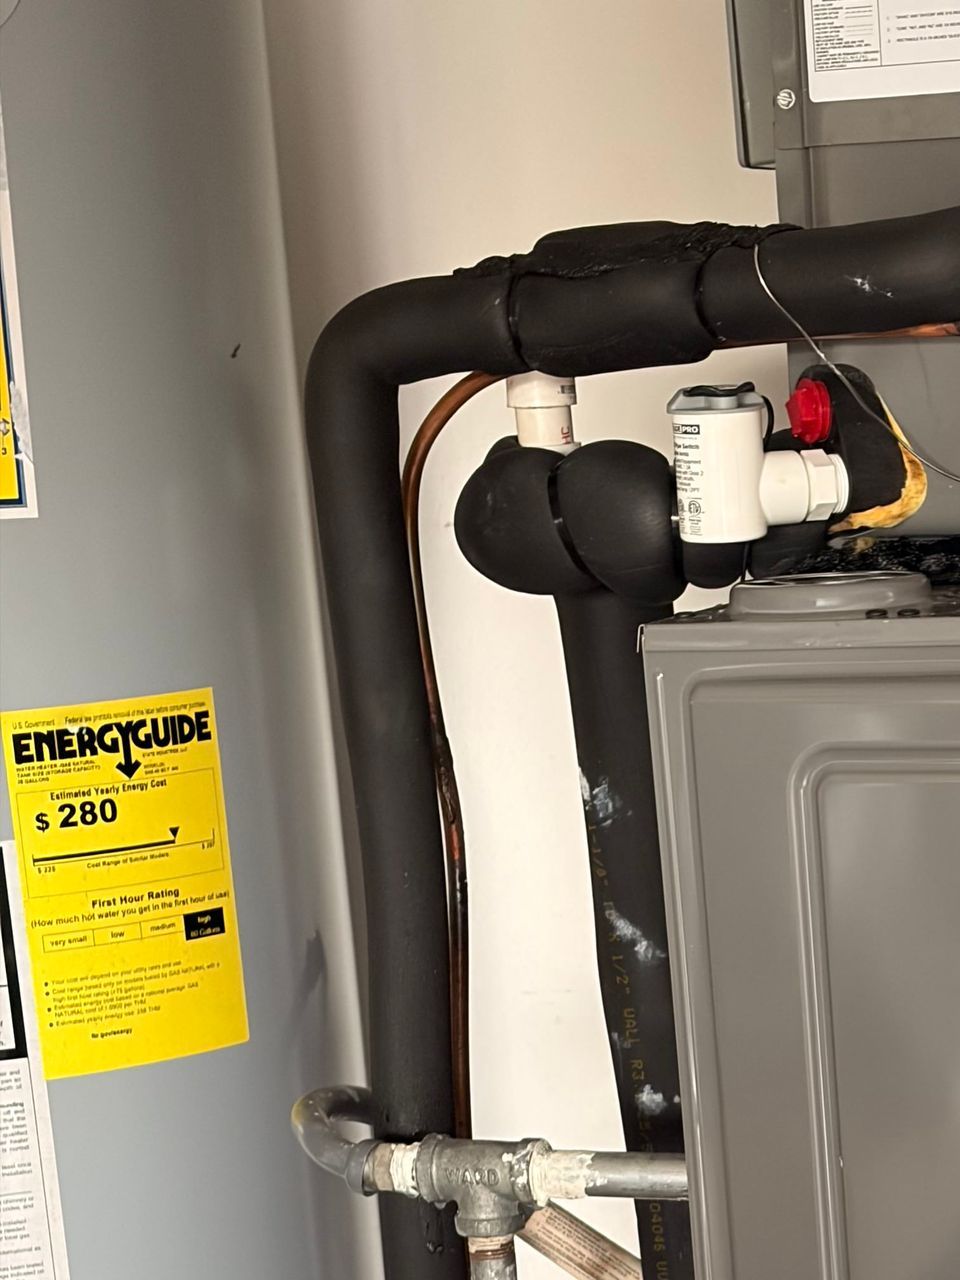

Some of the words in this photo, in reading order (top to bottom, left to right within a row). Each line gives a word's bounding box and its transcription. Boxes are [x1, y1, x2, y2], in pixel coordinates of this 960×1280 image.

[12, 710, 211, 767] ENERGYGUIDE
[50, 788, 91, 802] Estimated
[94, 784, 120, 797] Yearly
[122, 780, 149, 793] Energy
[151, 778, 167, 788] Cost
[35, 813, 49, 832] $
[58, 798, 117, 828] 280
[91, 897, 116, 908] First
[120, 893, 145, 904] Hour
[147, 887, 180, 901] Rating
[31, 918, 54, 929] (How
[55, 914, 80, 925] much
[81, 912, 96, 922] hot
[97, 909, 120, 919] water
[121, 907, 137, 918] you
[138, 905, 151, 915] get
[161, 900, 173, 909] the
[174, 898, 188, 907] first
[190, 894, 206, 903] hour
[110, 929, 125, 939] low
[150, 922, 176, 932] medium
[51, 939, 66, 947] very
[68, 936, 87, 944] small
